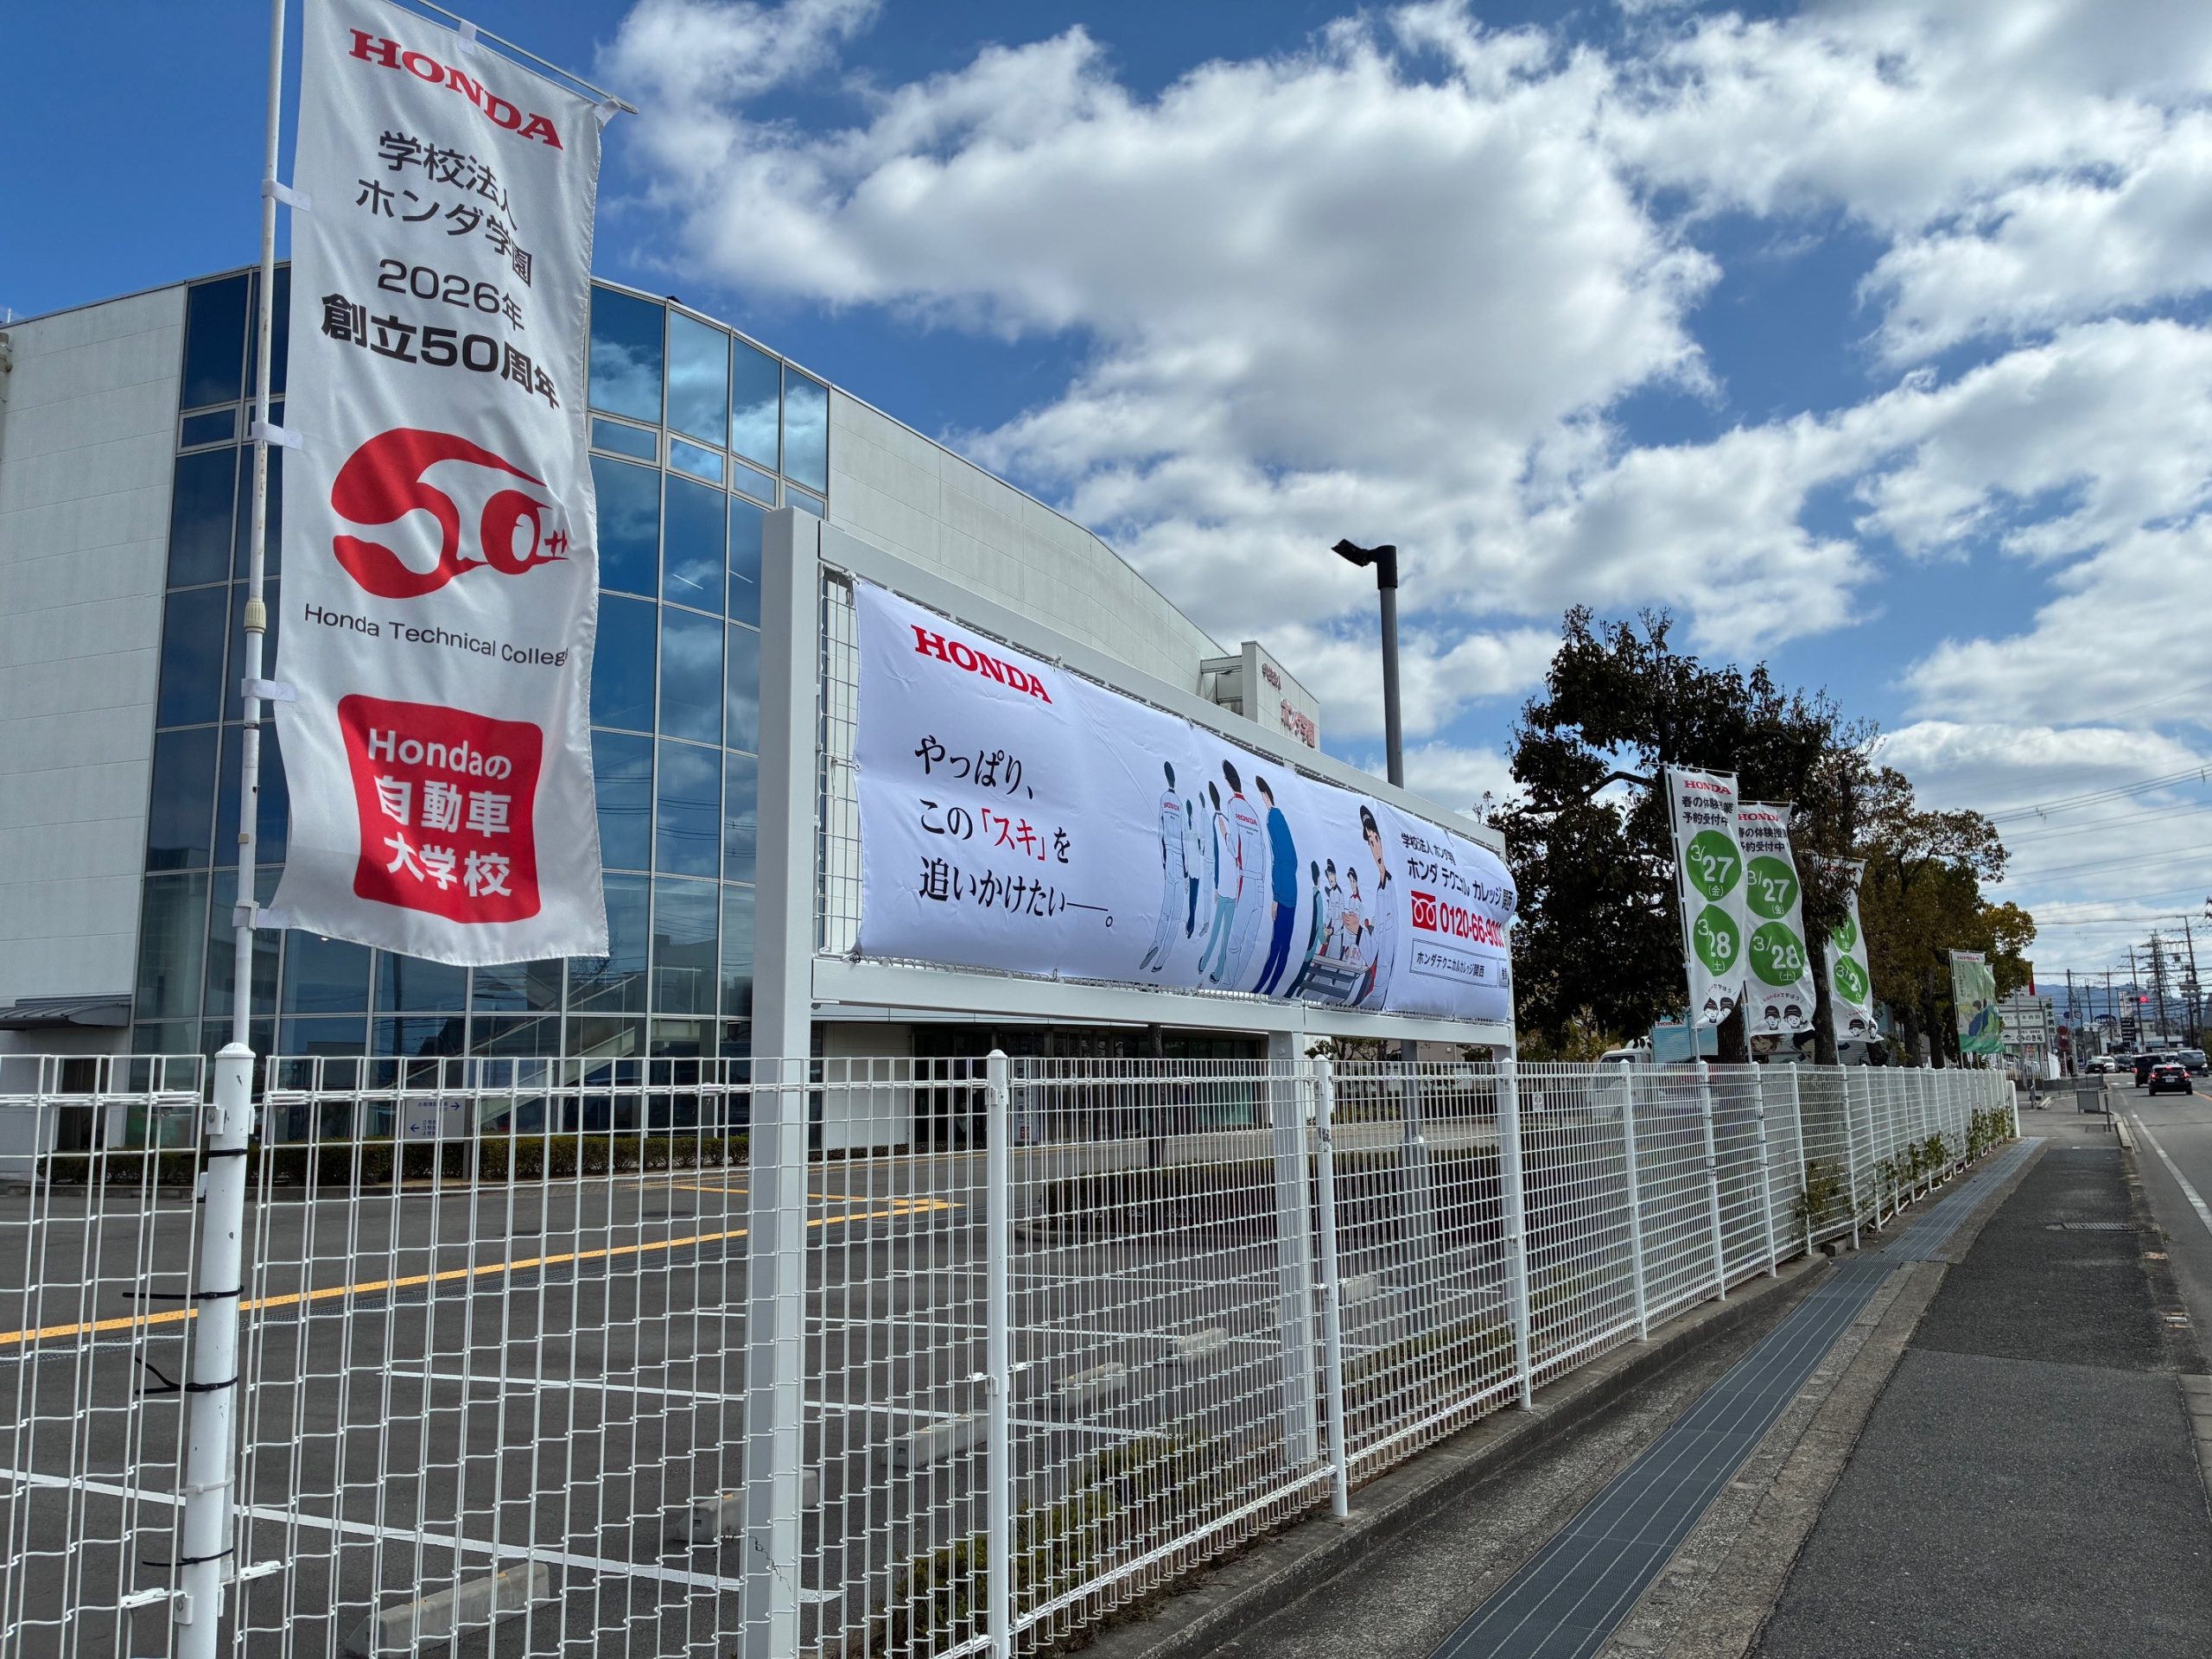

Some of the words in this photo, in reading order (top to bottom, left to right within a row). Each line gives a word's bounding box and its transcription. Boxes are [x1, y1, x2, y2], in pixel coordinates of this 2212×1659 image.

[348, 28, 563, 151] HONDA
[378, 130, 518, 232] 学校法人
[356, 179, 532, 288] ホンダ学園
[378, 258, 525, 332] 2026年
[321, 293, 560, 410] 創立50周年
[305, 602, 381, 639] Honda
[388, 620, 497, 658] Technical
[501, 644, 569, 667] Colleg
[910, 624, 1052, 704] HONDA
[367, 728, 512, 780] Hondaの
[914, 734, 1034, 800] やっぱり、
[373, 775, 511, 837] 自動車
[1236, 813, 1258, 826] HONDA
[1683, 779, 1732, 795] HONDA
[918, 798, 1071, 865] この「スキ」を
[1690, 844, 1735, 883] 3/27
[383, 832, 512, 898] 大学校
[1407, 856, 1438, 884] ホンダ
[1472, 880, 1502, 906] カレッジ
[1747, 870, 1790, 903] 3/27
[1752, 935, 1802, 969] 3/28
[1779, 970, 1796, 982] (土)
